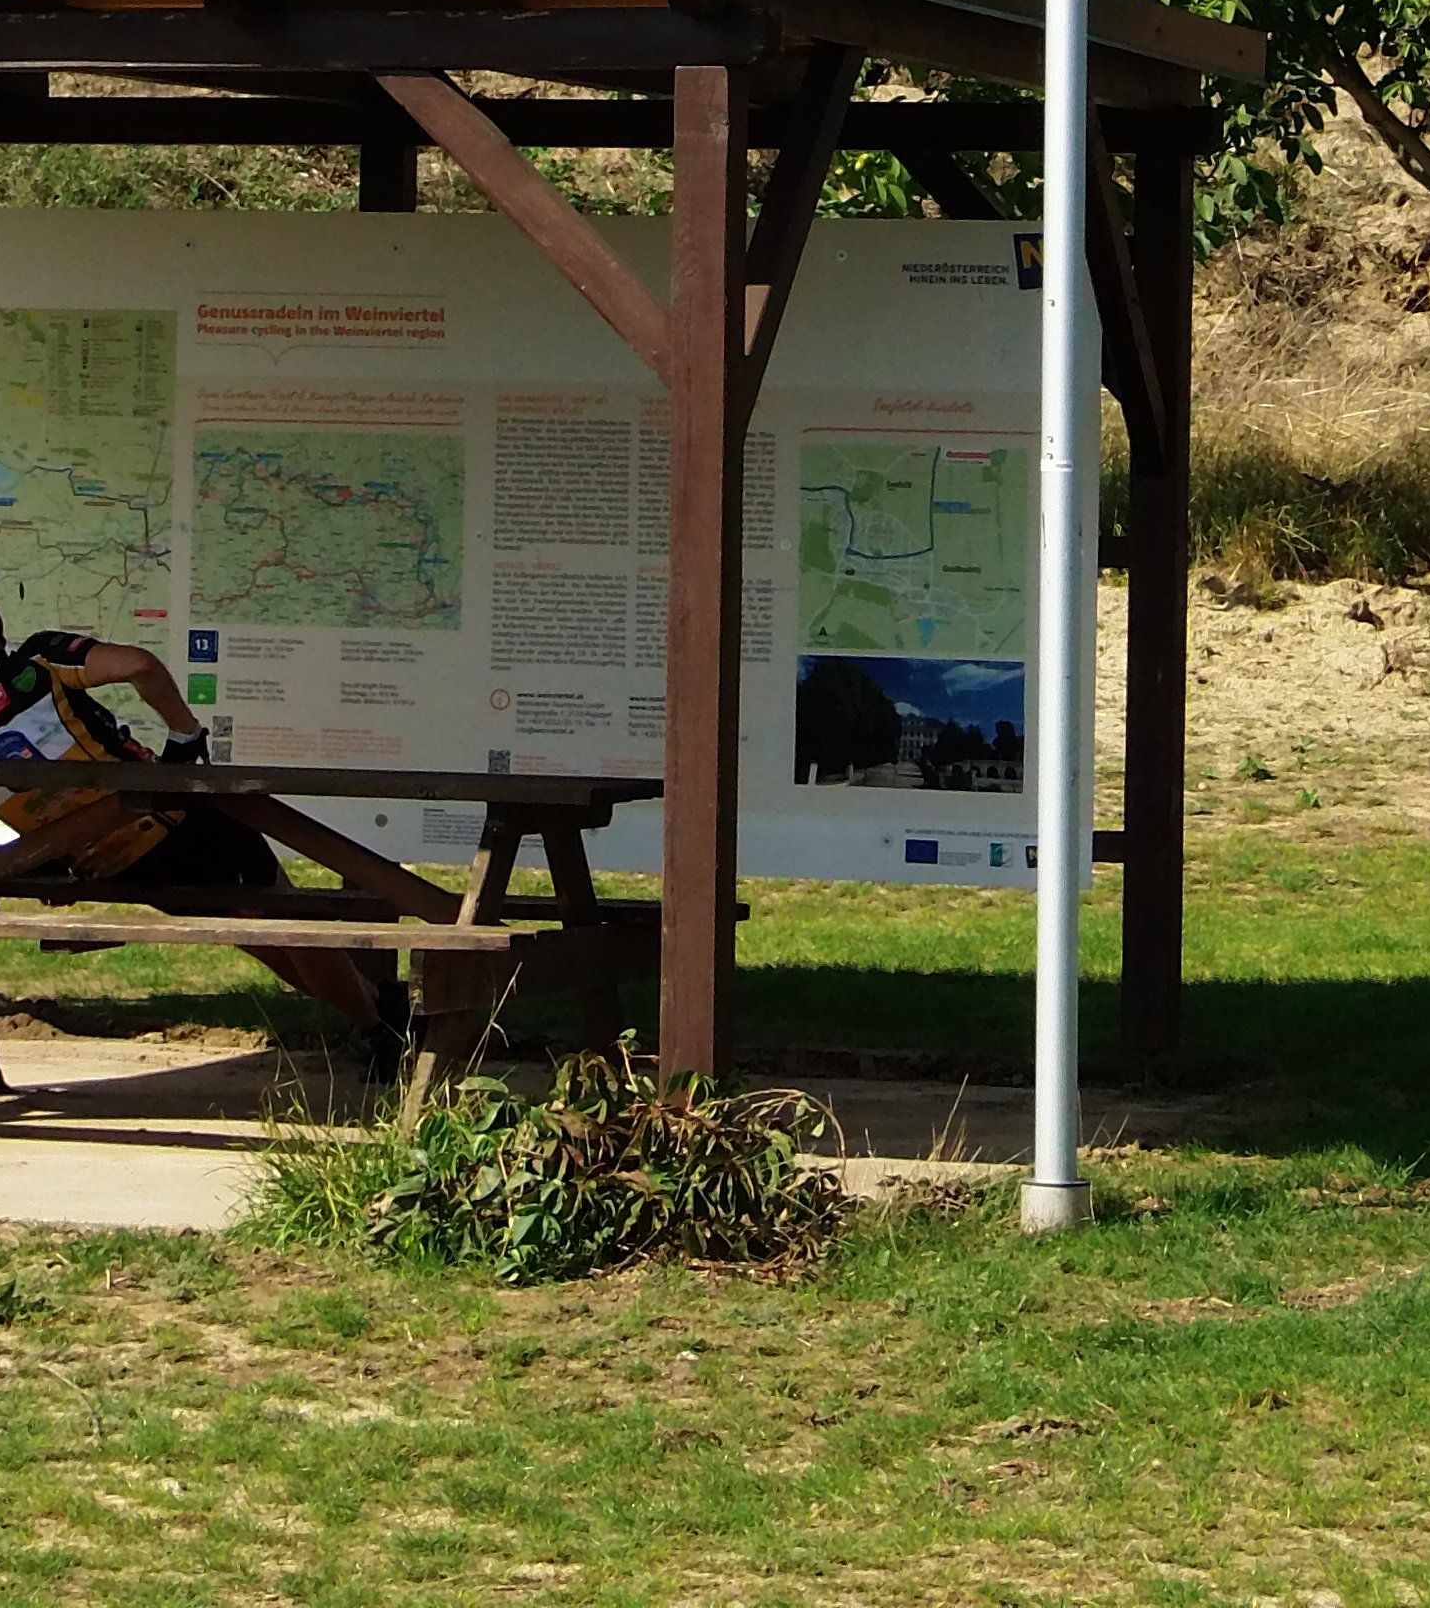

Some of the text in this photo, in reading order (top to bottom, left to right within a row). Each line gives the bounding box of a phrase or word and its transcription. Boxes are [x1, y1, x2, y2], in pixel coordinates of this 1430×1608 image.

[902, 261, 1009, 274] NIEDERÖSTERREICH
[197, 303, 445, 323] Genussradeln im Weinviertel
[197, 323, 445, 340] Pleasure cycling in the Weinviertel region
[195, 639, 209, 651] 13
